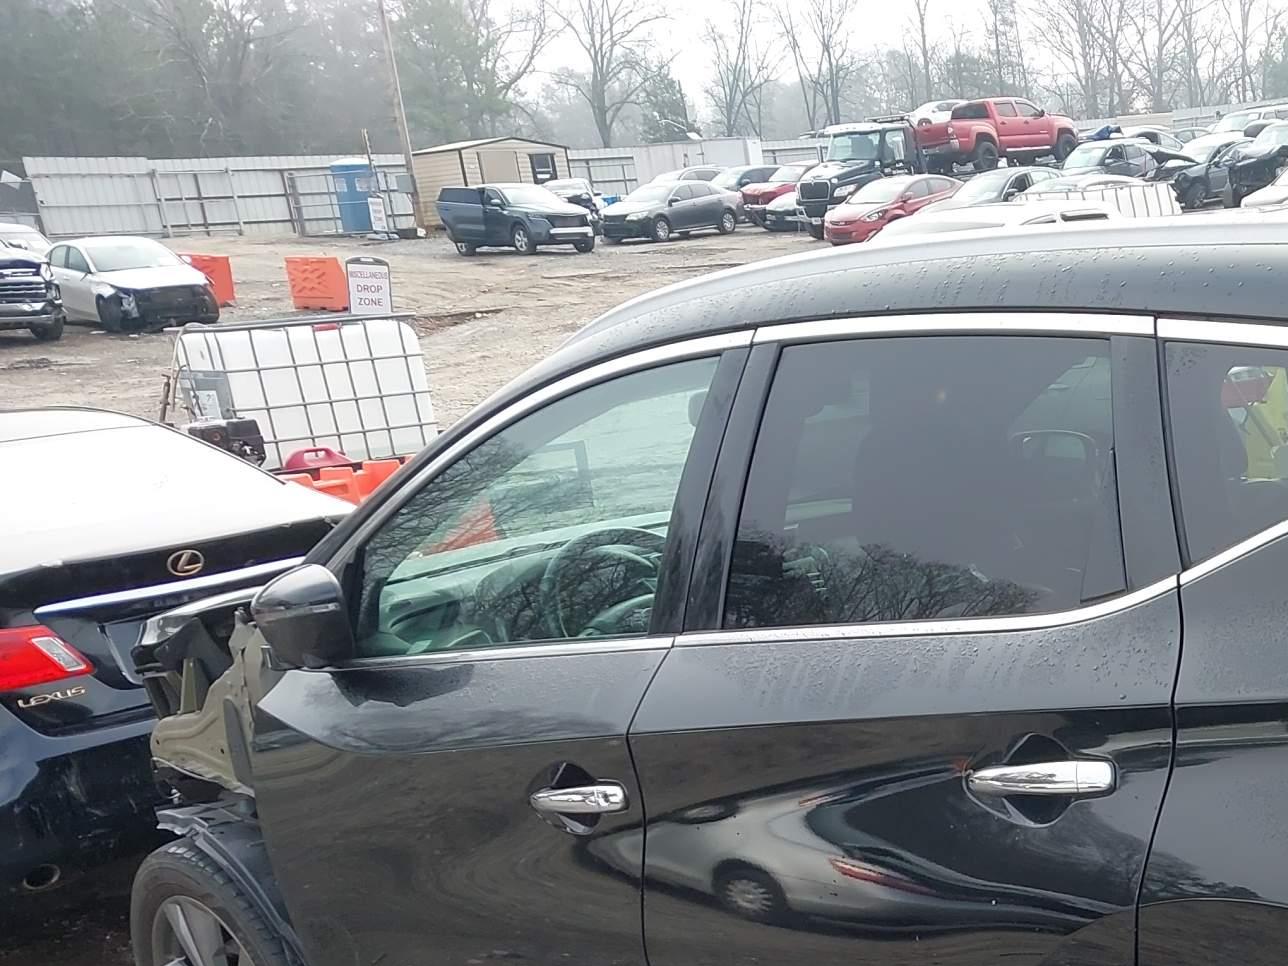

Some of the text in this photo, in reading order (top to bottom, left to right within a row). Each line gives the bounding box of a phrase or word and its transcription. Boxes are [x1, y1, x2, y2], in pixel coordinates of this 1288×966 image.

[356, 284, 383, 294] DROP
[357, 297, 384, 307] ZONE
[17, 685, 86, 708] LEXUS
